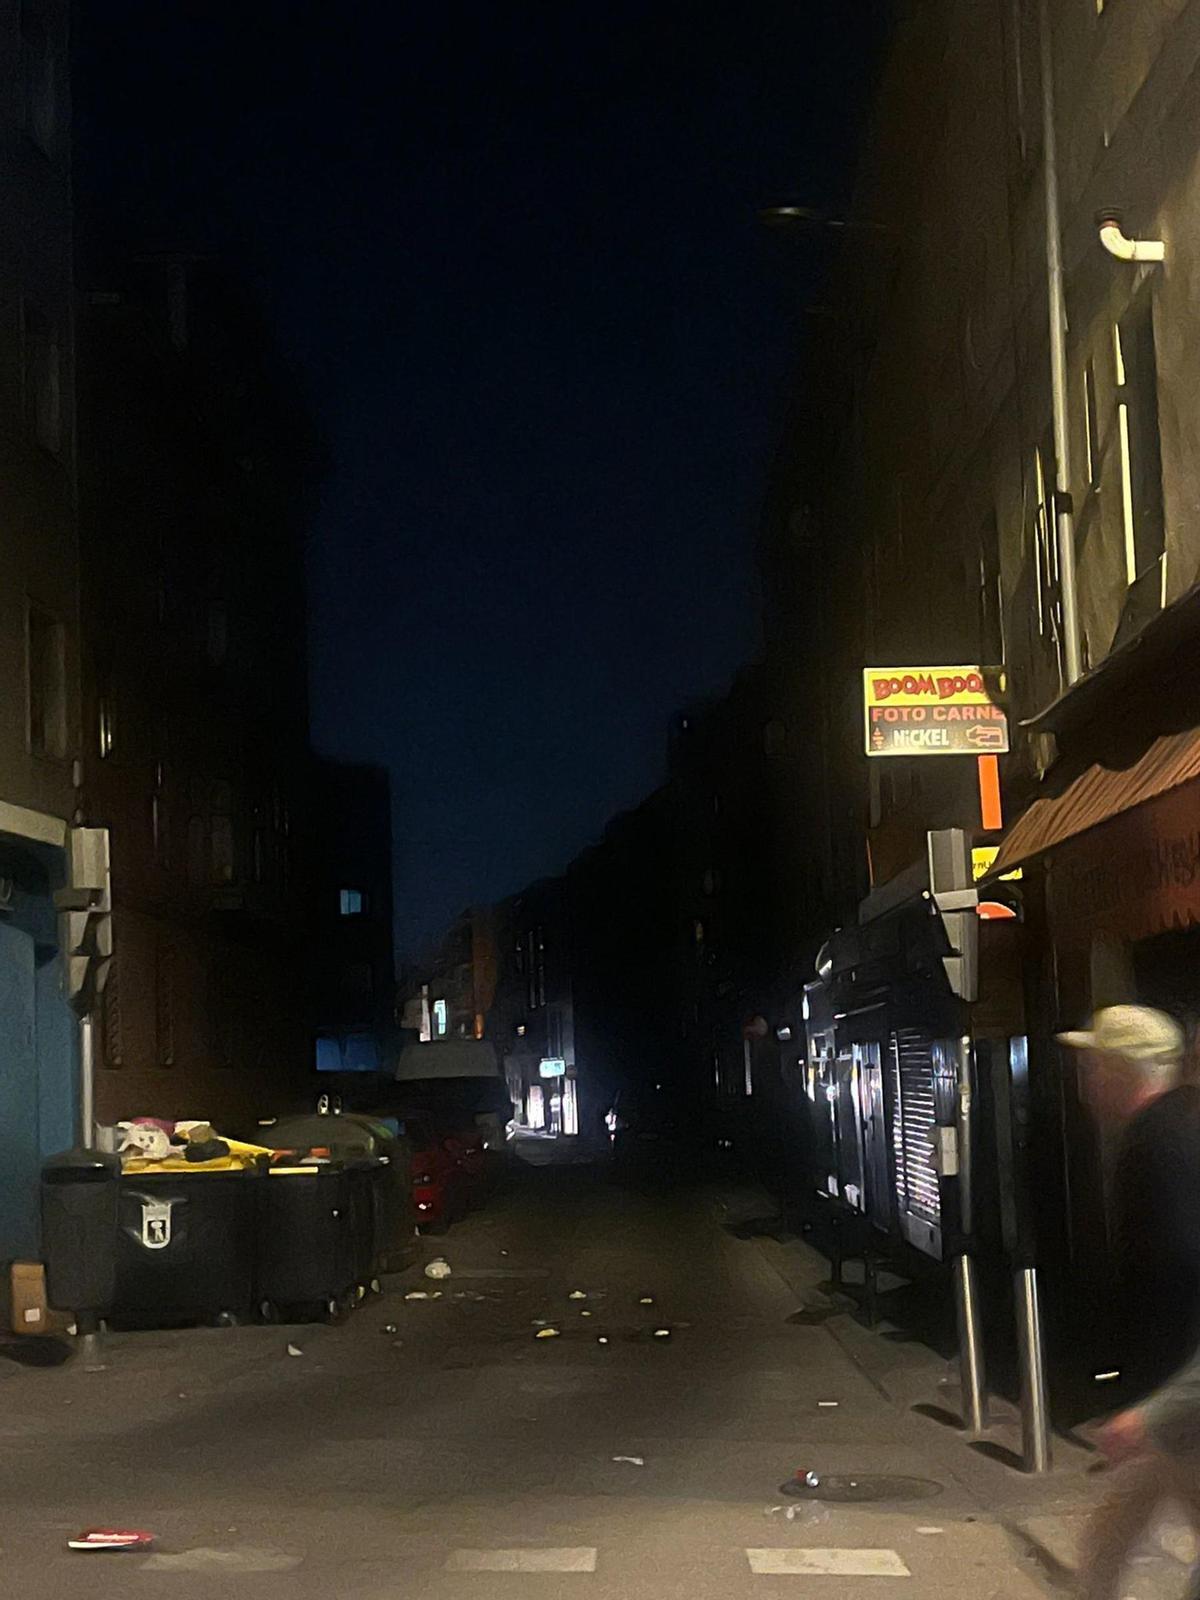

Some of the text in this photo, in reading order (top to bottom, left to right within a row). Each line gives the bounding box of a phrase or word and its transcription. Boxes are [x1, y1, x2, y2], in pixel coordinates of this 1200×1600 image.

[872, 673, 985, 701] BOOM BOO
[872, 707, 927, 722] FOTO
